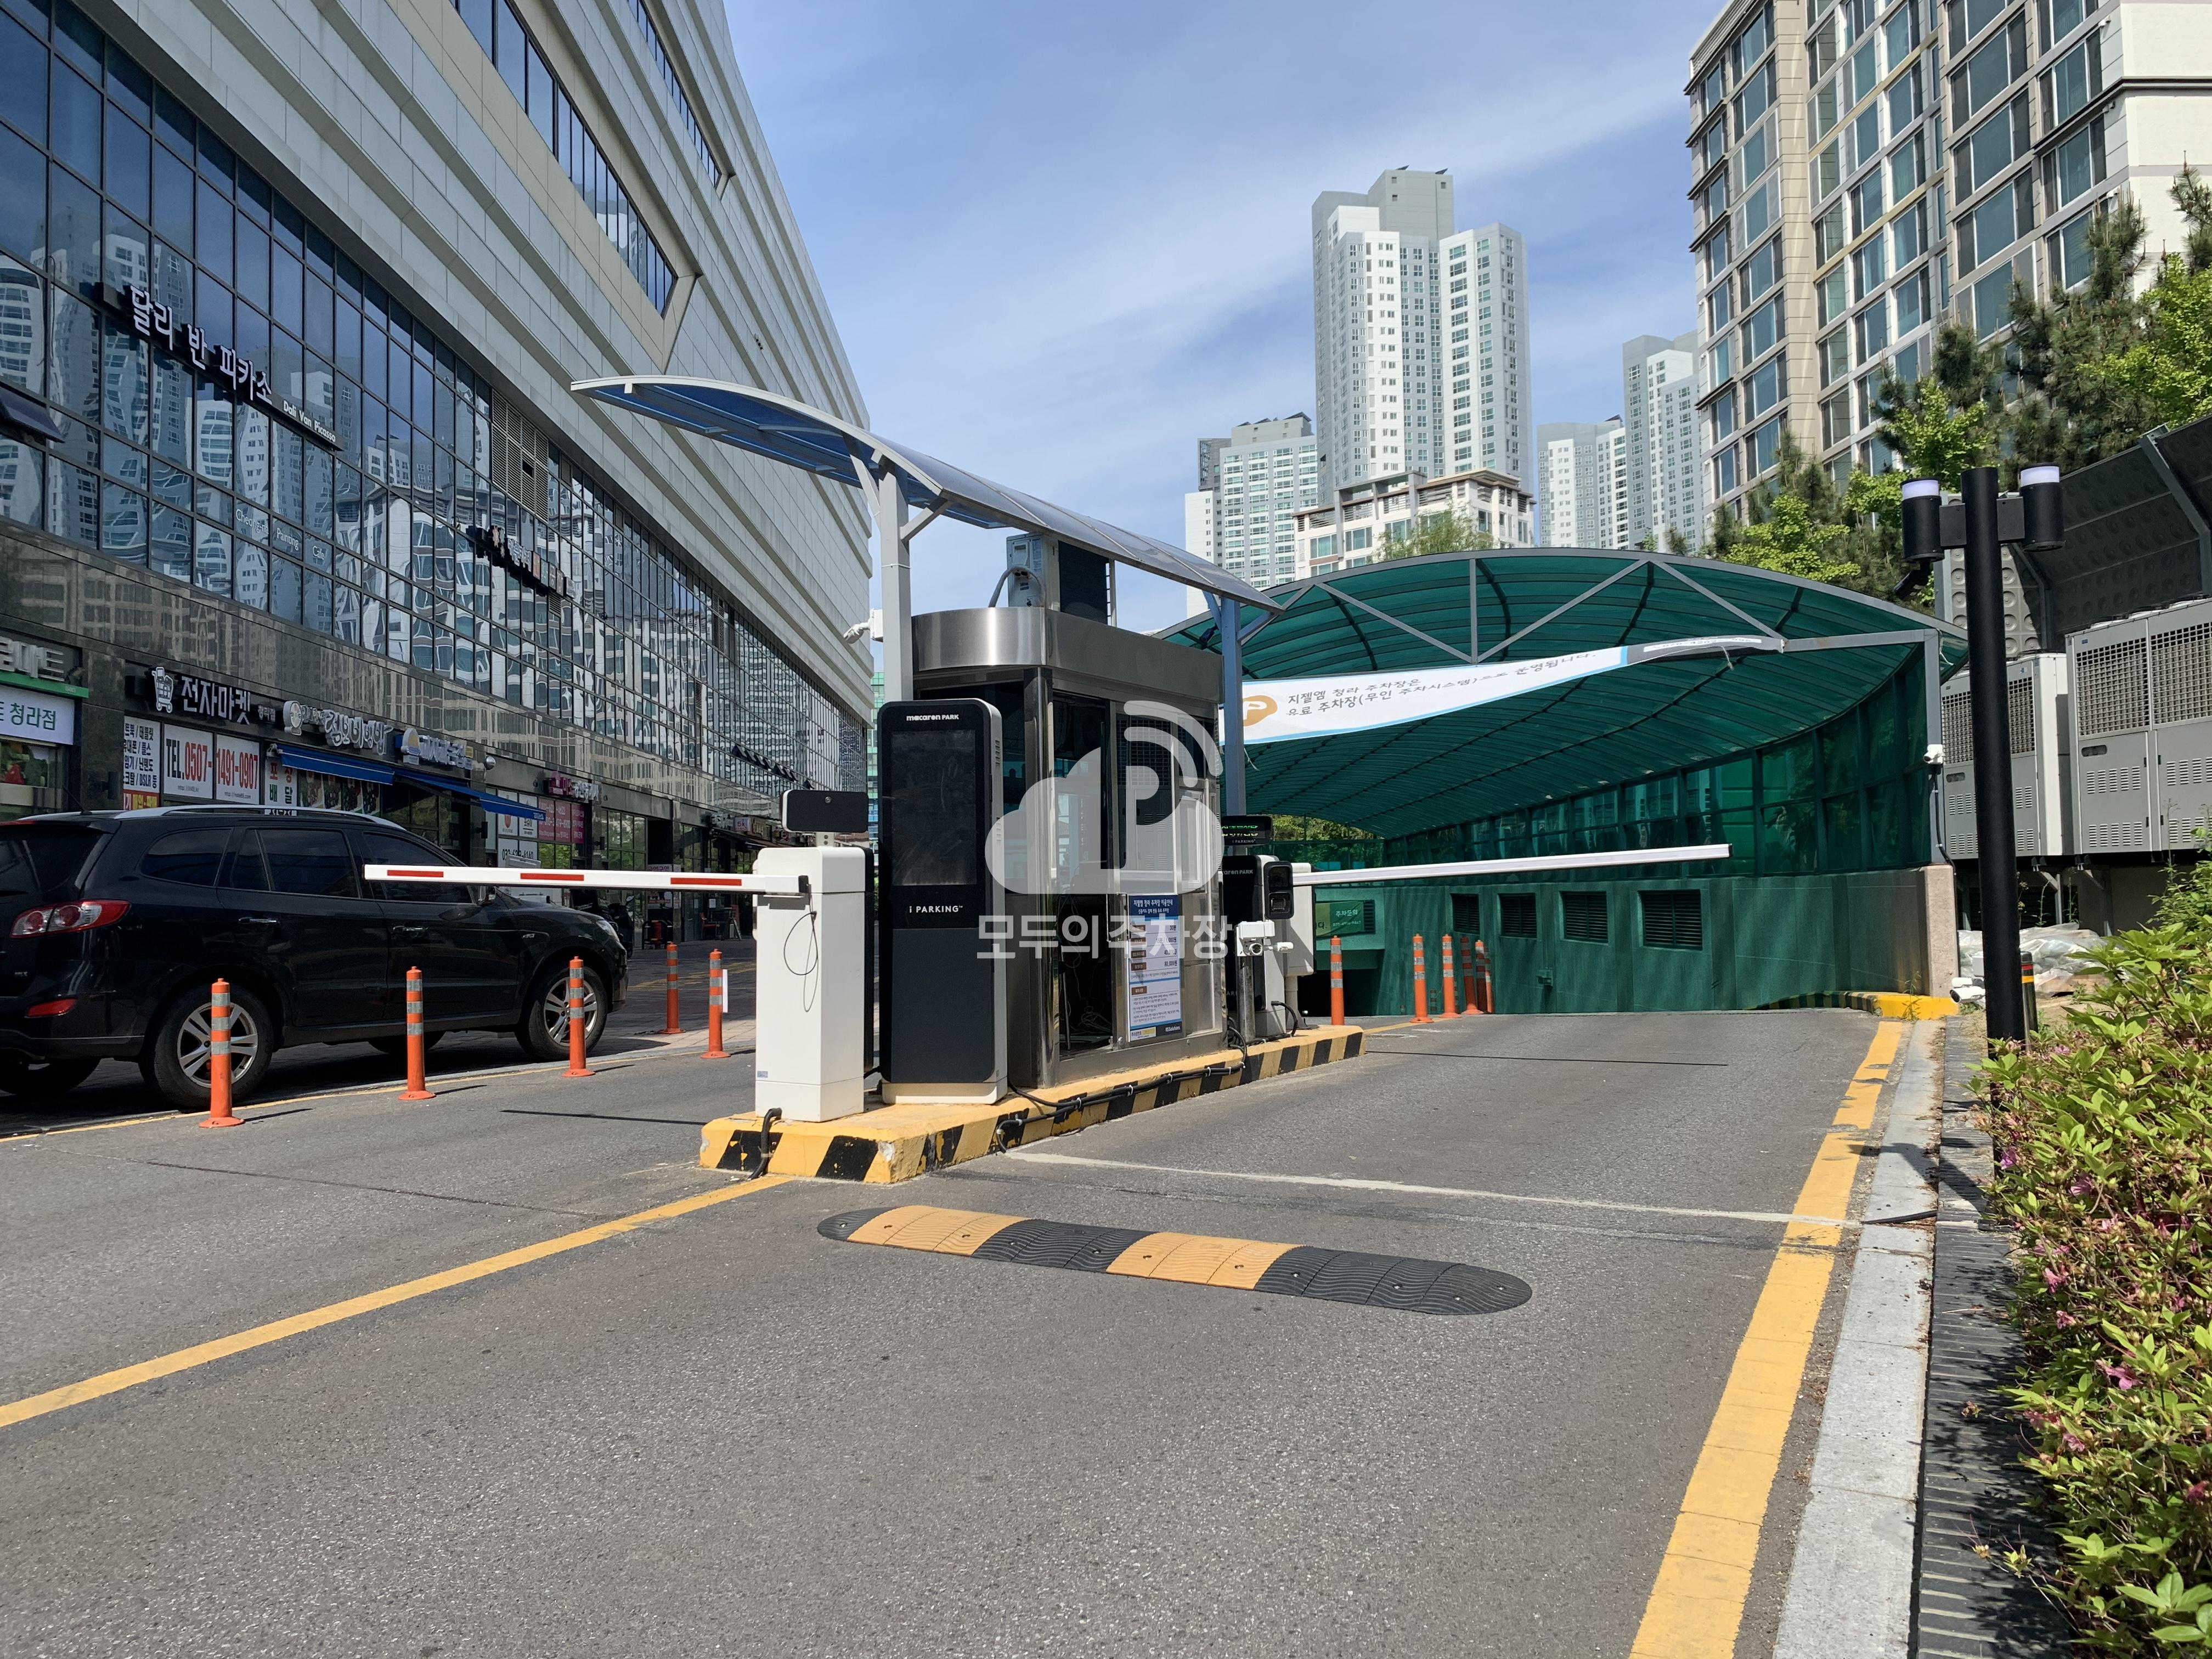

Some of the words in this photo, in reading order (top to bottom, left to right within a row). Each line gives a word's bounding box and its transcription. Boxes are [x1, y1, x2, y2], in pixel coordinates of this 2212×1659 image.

[131, 285, 173, 351] 달리
[188, 324, 206, 370] 반
[219, 345, 272, 405] 피카소
[283, 400, 296, 417] Dali
[299, 410, 312, 427] Van
[314, 420, 336, 443] Picasso
[276, 528, 299, 550] Painting
[181, 676, 251, 725] 전자마켓
[1286, 706, 1312, 716] 유료
[1318, 690, 1392, 712] 주차장(무인
[1288, 690, 1326, 704] 지젤엠
[1332, 686, 1360, 695] 청라
[1367, 678, 1421, 692] 주차장은
[10, 703, 56, 731] 청라점
[123, 771, 135, 786] 크탑
[139, 774, 151, 787] DSLR
